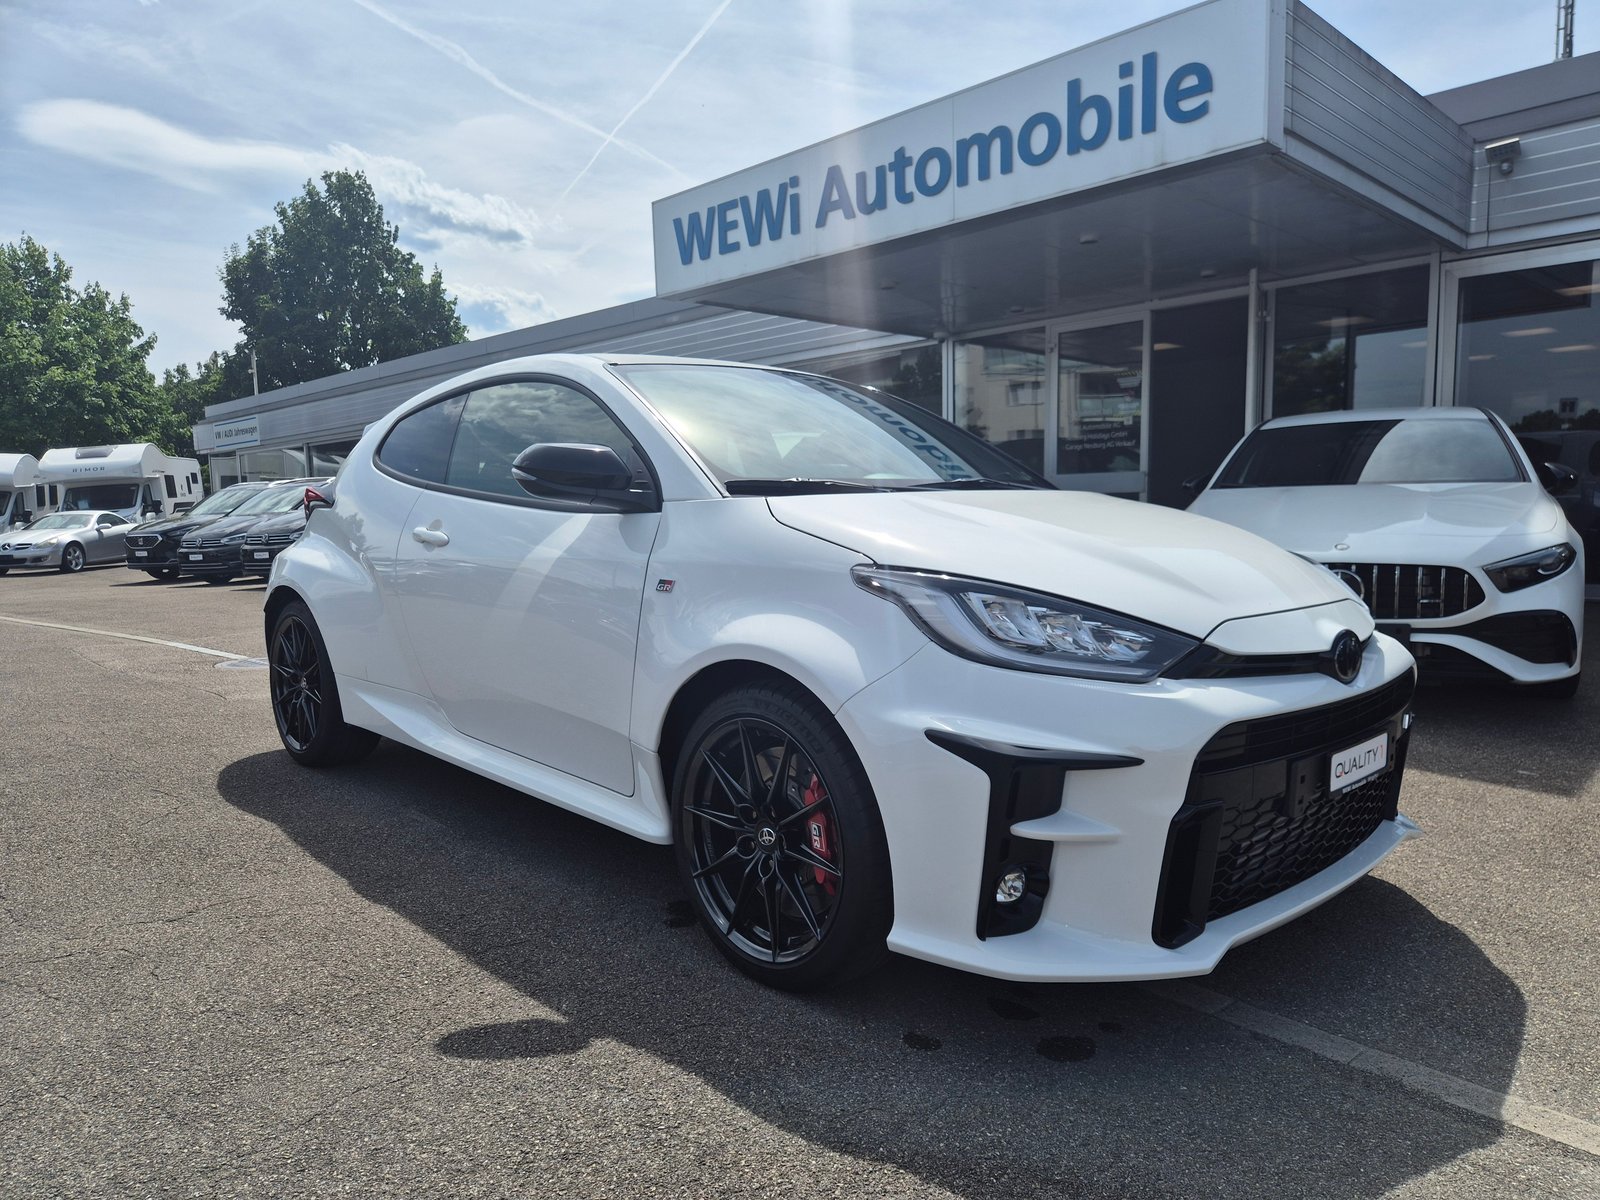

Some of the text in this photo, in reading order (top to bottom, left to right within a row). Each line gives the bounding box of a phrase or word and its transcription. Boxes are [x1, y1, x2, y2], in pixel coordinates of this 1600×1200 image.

[673, 51, 1214, 266] WEWi Automobile
[1335, 746, 1379, 779] QUALITY
